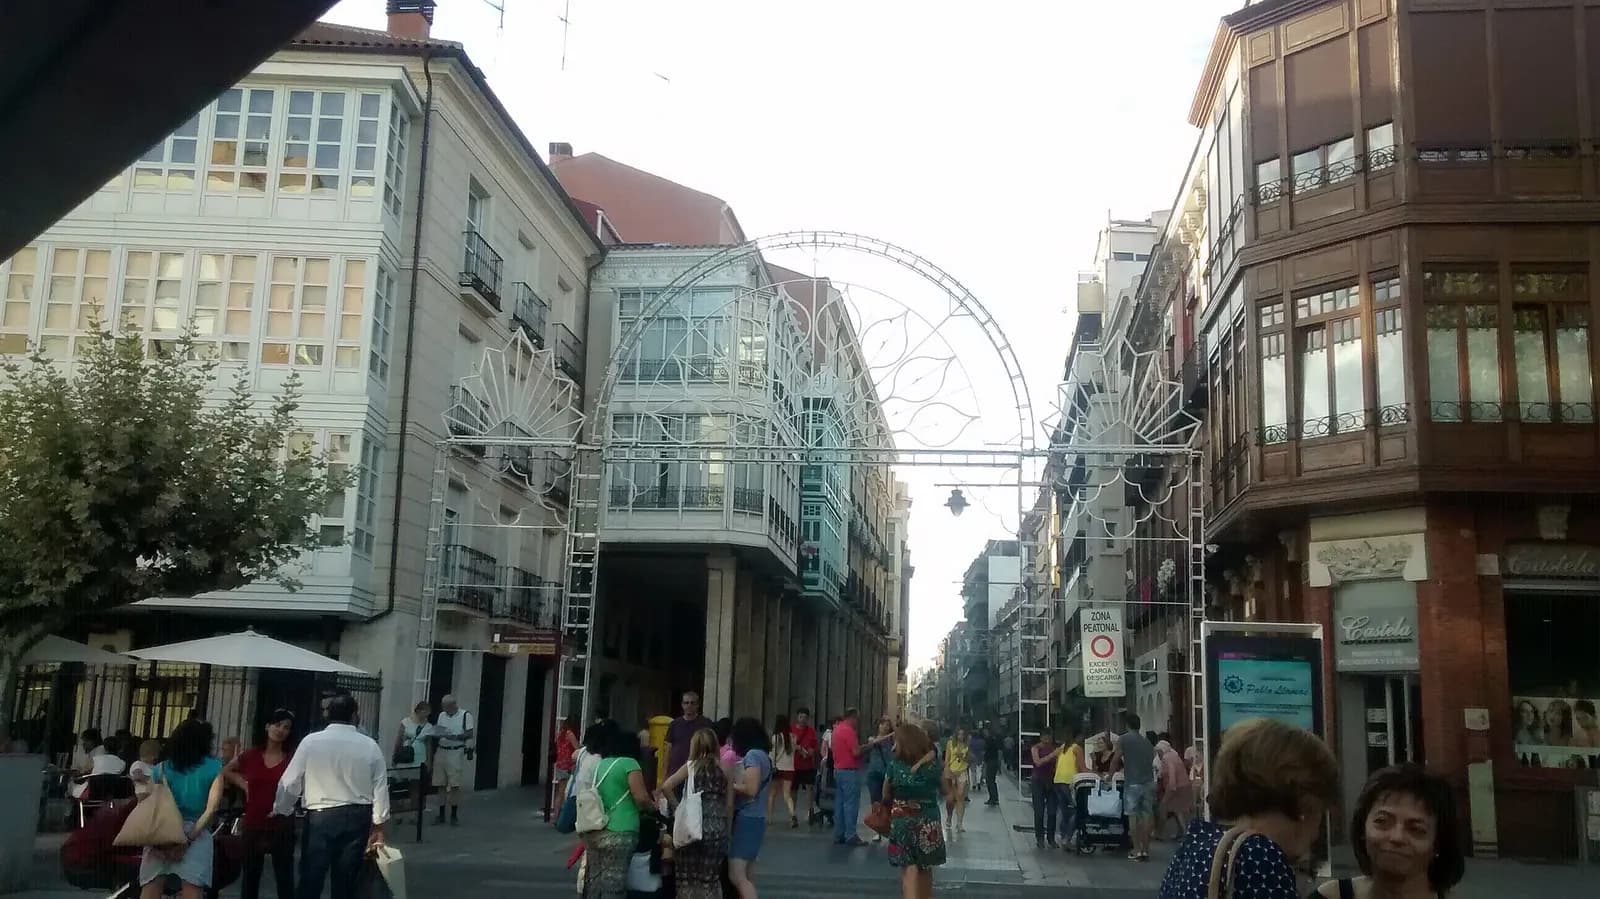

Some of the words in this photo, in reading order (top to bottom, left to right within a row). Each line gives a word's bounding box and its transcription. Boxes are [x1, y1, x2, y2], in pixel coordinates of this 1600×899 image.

[1091, 611, 1111, 620] ZONA
[1083, 623, 1120, 632] PEATONAL
[1341, 615, 1413, 640] Castela
